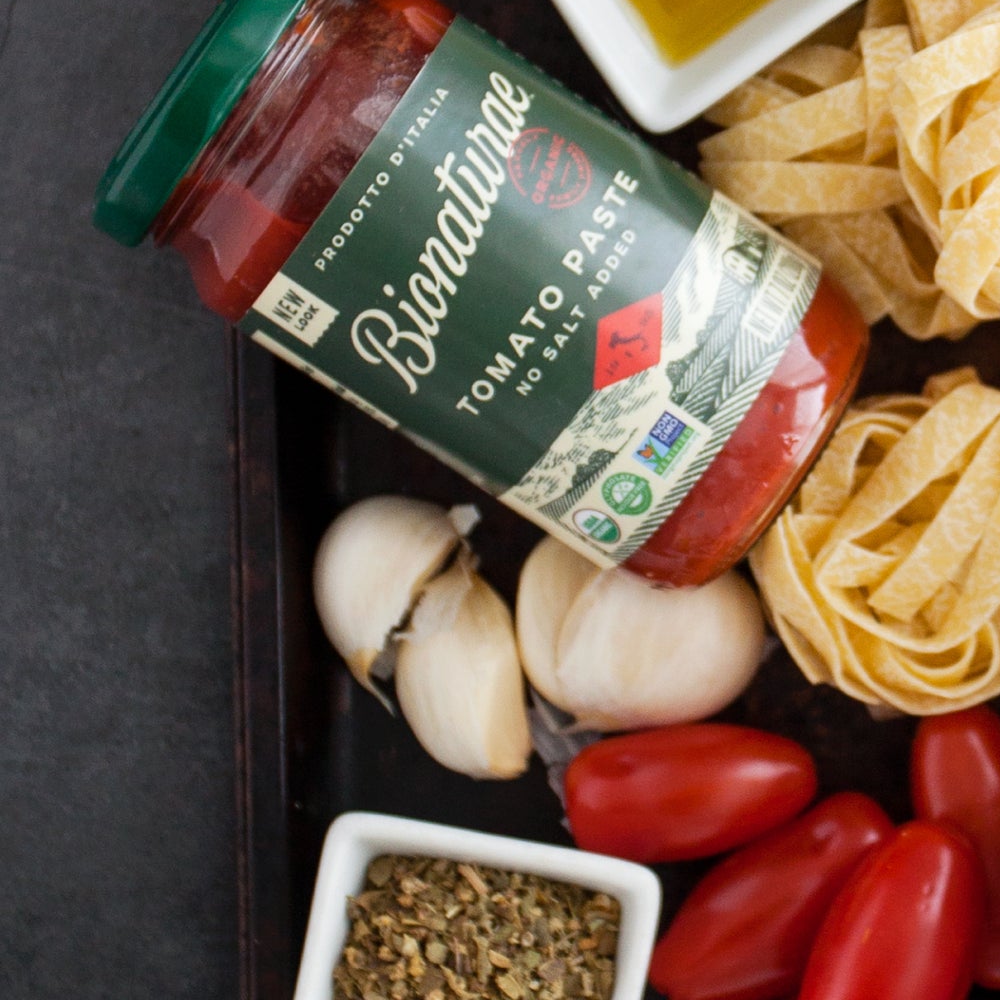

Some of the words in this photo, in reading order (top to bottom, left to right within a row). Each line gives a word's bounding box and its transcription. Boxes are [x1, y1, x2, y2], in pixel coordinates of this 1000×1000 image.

[314, 171, 390, 272] PRODOTTO
[389, 86, 449, 167] D'ITALIA
[350, 71, 532, 395] Bionaturae
[272, 288, 306, 322] NEW
[455, 284, 564, 416] TOMATO
[561, 169, 639, 276] PASTE
[515, 367, 542, 397] NO
[542, 304, 586, 361] SALT
[586, 229, 637, 301] ADDED
[294, 303, 321, 332] LOOK
[652, 413, 672, 437] NON
[658, 418, 680, 441] GMO
[655, 426, 694, 475] VERIFIED
